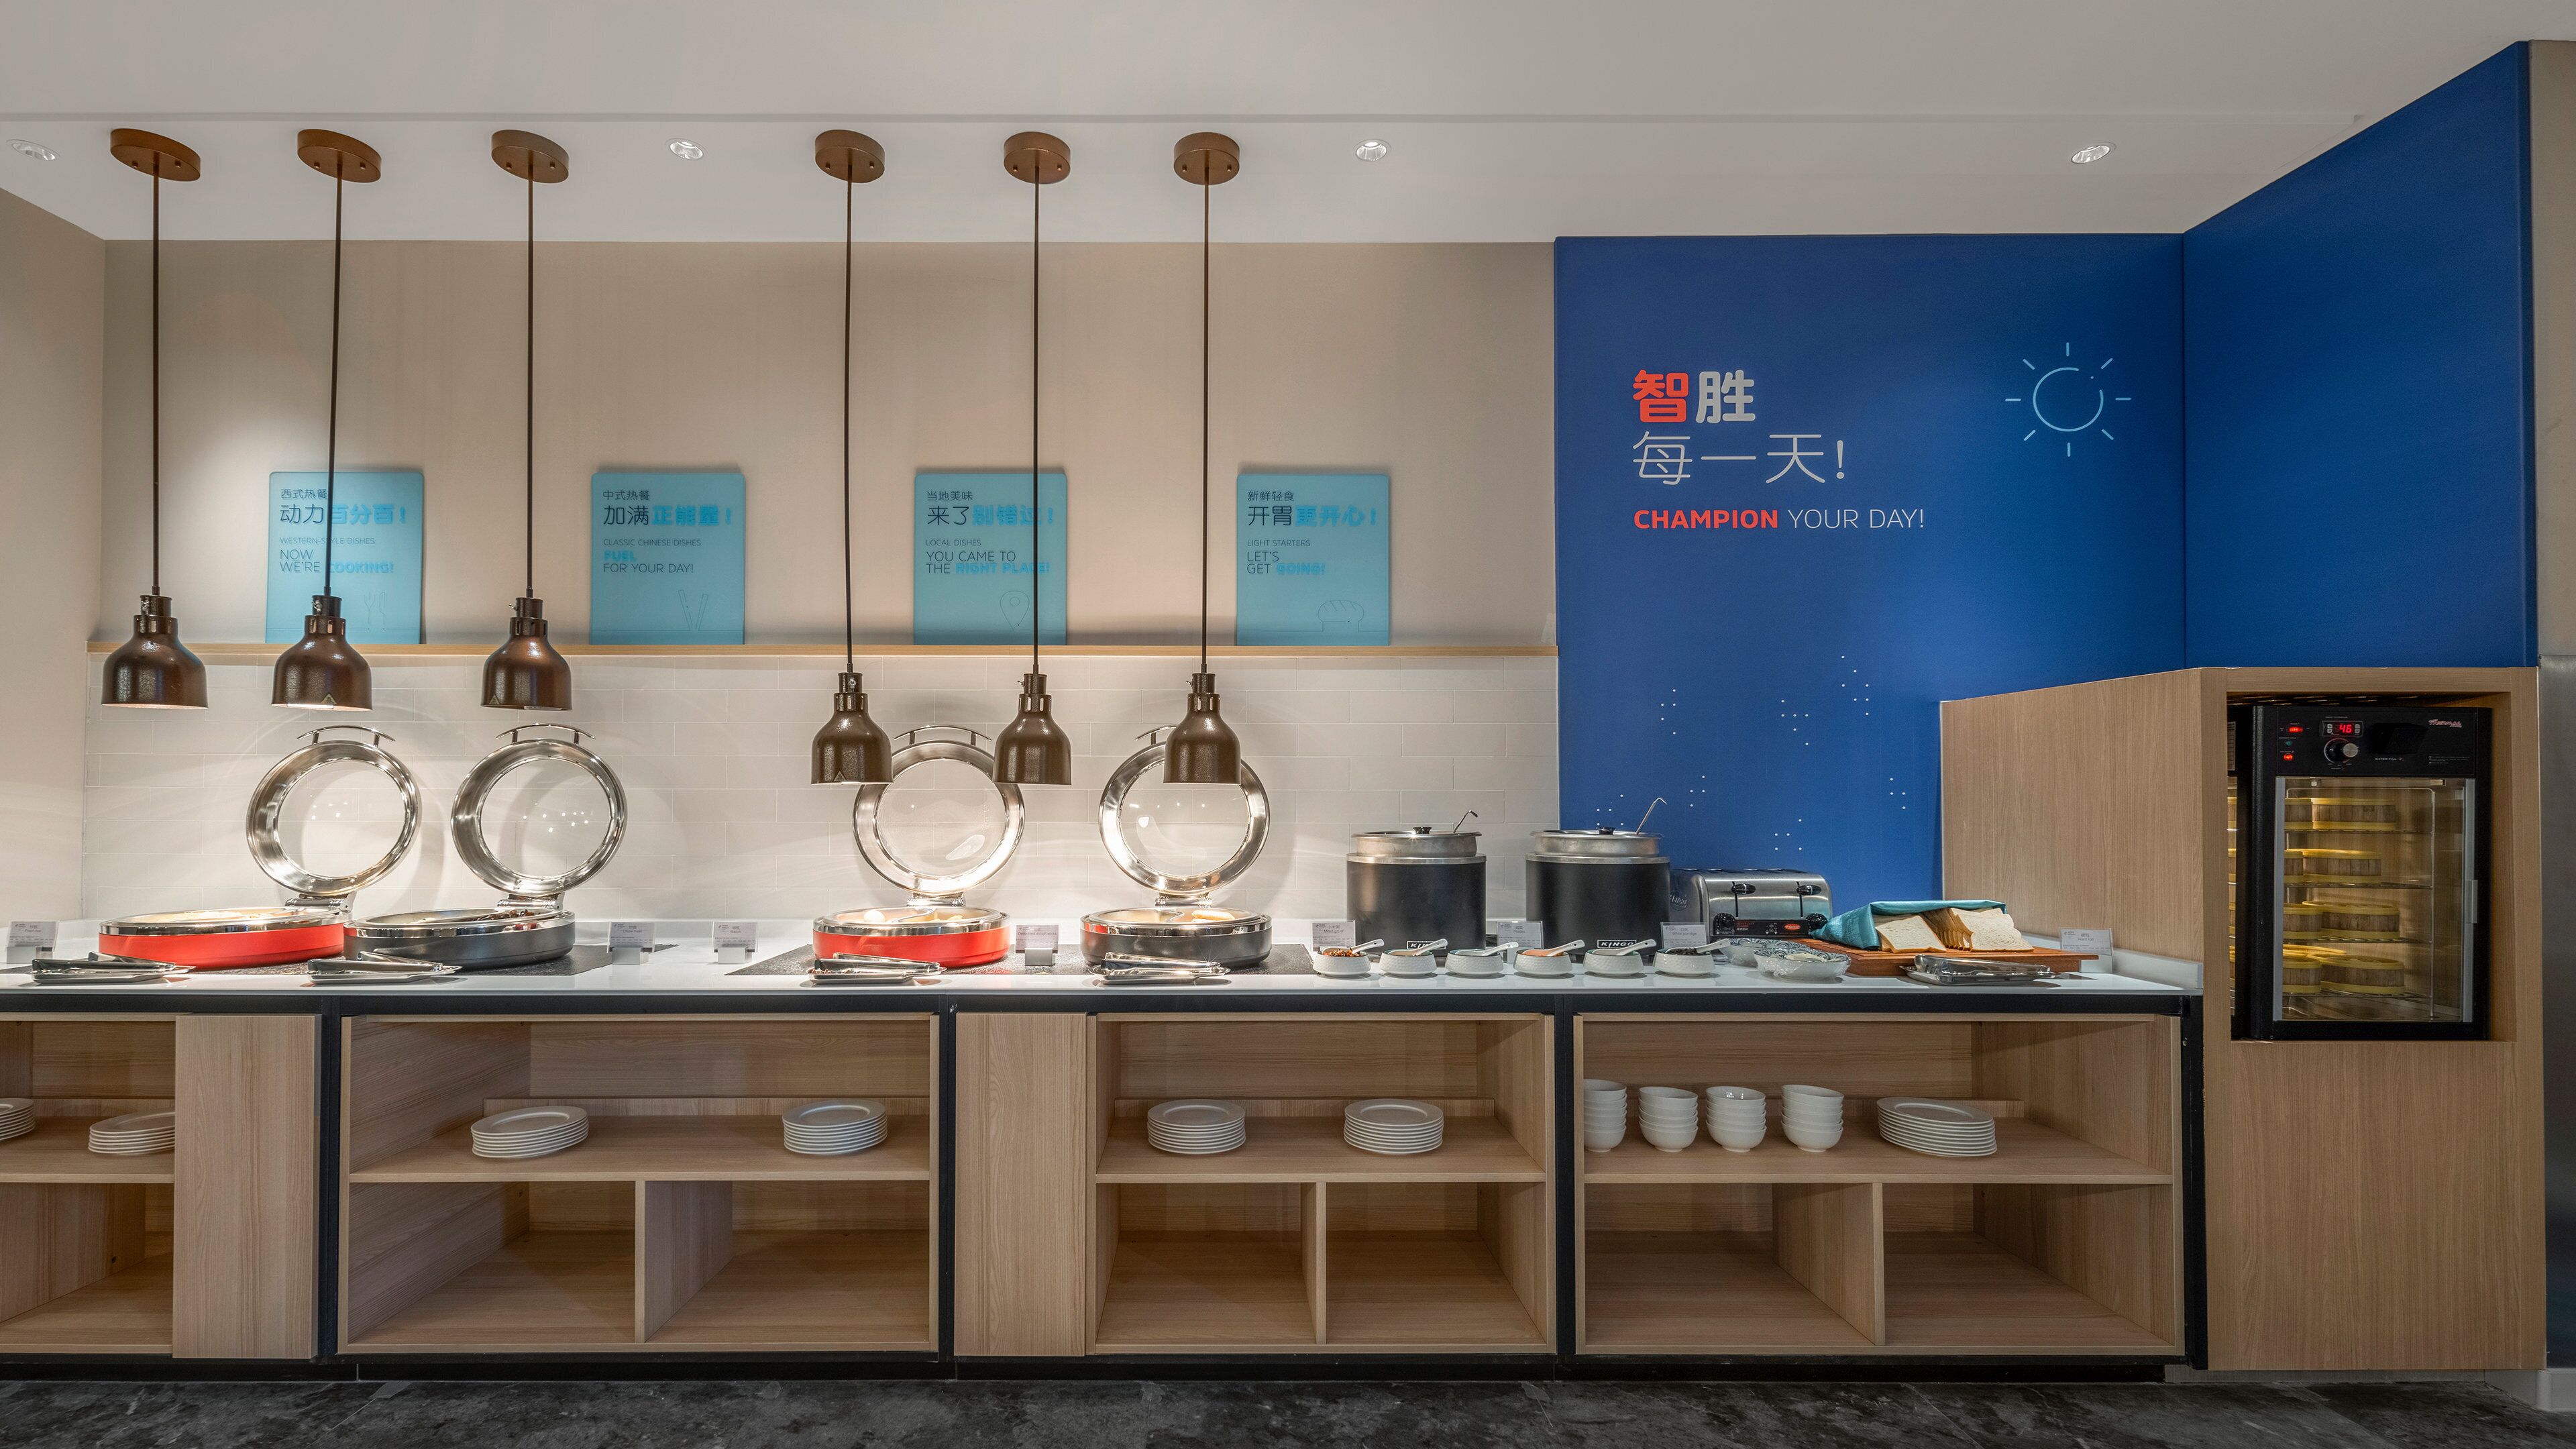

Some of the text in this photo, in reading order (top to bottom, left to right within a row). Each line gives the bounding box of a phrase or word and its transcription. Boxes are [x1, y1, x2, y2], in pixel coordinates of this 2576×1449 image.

[1633, 370, 1756, 423] 智胜
[1633, 431, 1844, 485] 每一天!
[280, 488, 327, 500] 西式热餐
[603, 490, 650, 501] 中式热餐
[926, 491, 973, 502] 当地美味
[1247, 490, 1295, 502] 新鲜轻食
[1633, 508, 1925, 529] CHAMPION YOUR DAY!
[603, 539, 702, 547] CLASSIC CHINESE DISHES
[926, 539, 981, 547] LOCAL DISHES
[280, 549, 314, 560] NOW
[604, 549, 637, 562] FUEL
[926, 551, 1016, 562] YOU CAME TO
[1247, 551, 1279, 562] LET'S
[280, 561, 321, 572] WE'RE
[604, 563, 694, 574] FOR YOUR DAY!
[926, 563, 951, 574] THE
[955, 562, 998, 575] RIGHT
[1247, 562, 1326, 576] GET GOING!
[2339, 723, 2353, 734] 46
